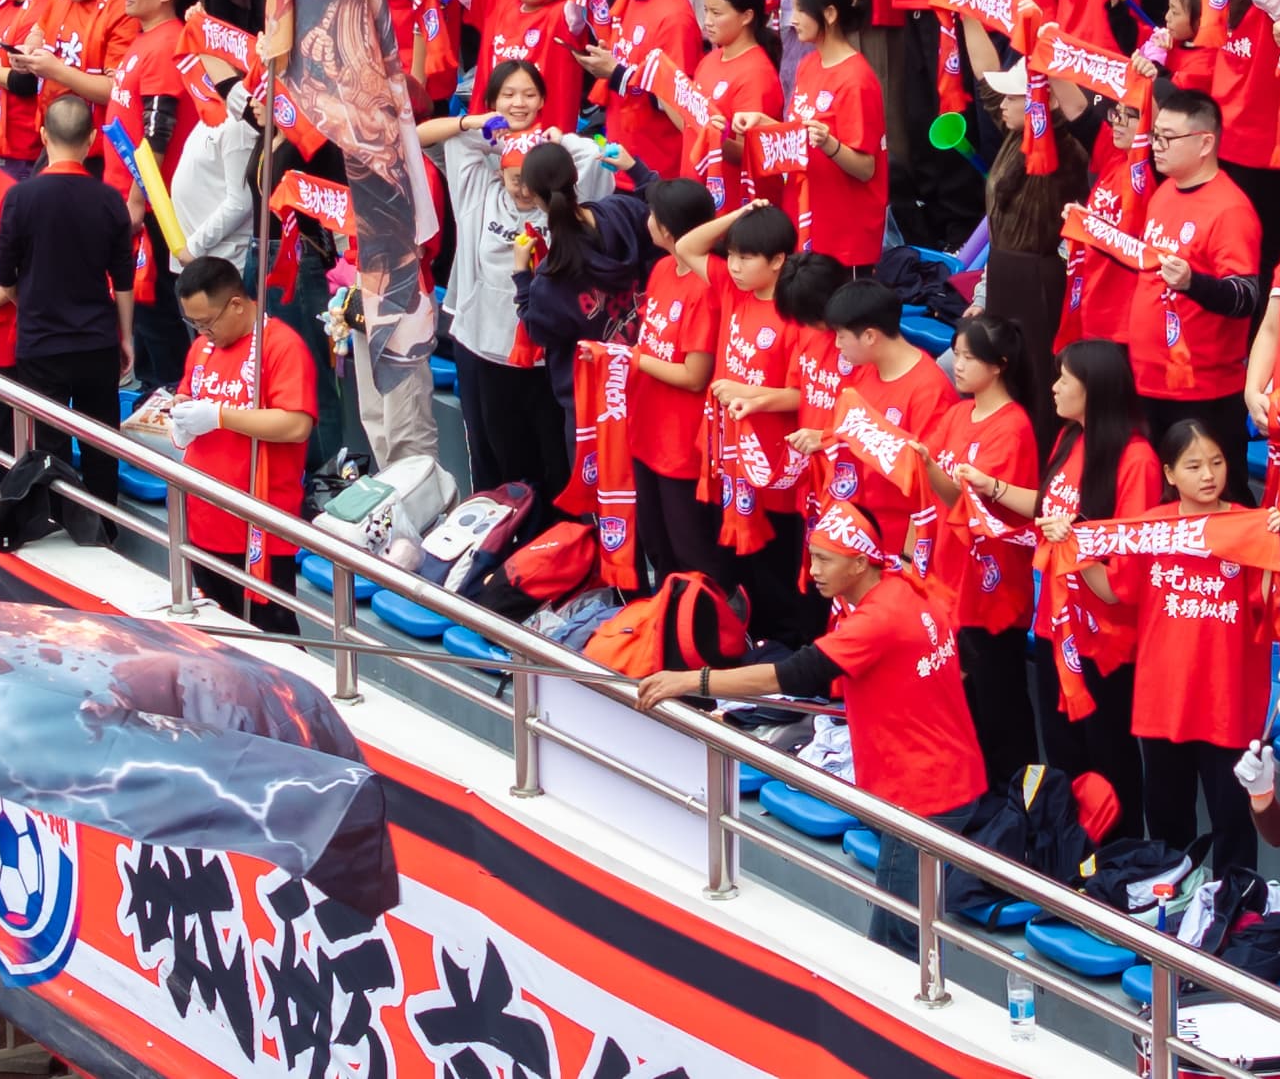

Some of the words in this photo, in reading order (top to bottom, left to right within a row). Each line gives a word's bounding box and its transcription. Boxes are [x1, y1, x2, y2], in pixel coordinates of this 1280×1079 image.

[1048, 37, 1126, 98] 彭水雄起
[760, 128, 809, 171] 彭水雄起
[297, 179, 348, 226] 彭水雄起
[1075, 515, 1213, 562] 彭水雄起
[1150, 562, 1225, 599] 蚩尤战神
[1163, 592, 1240, 624] 赛场纵横
